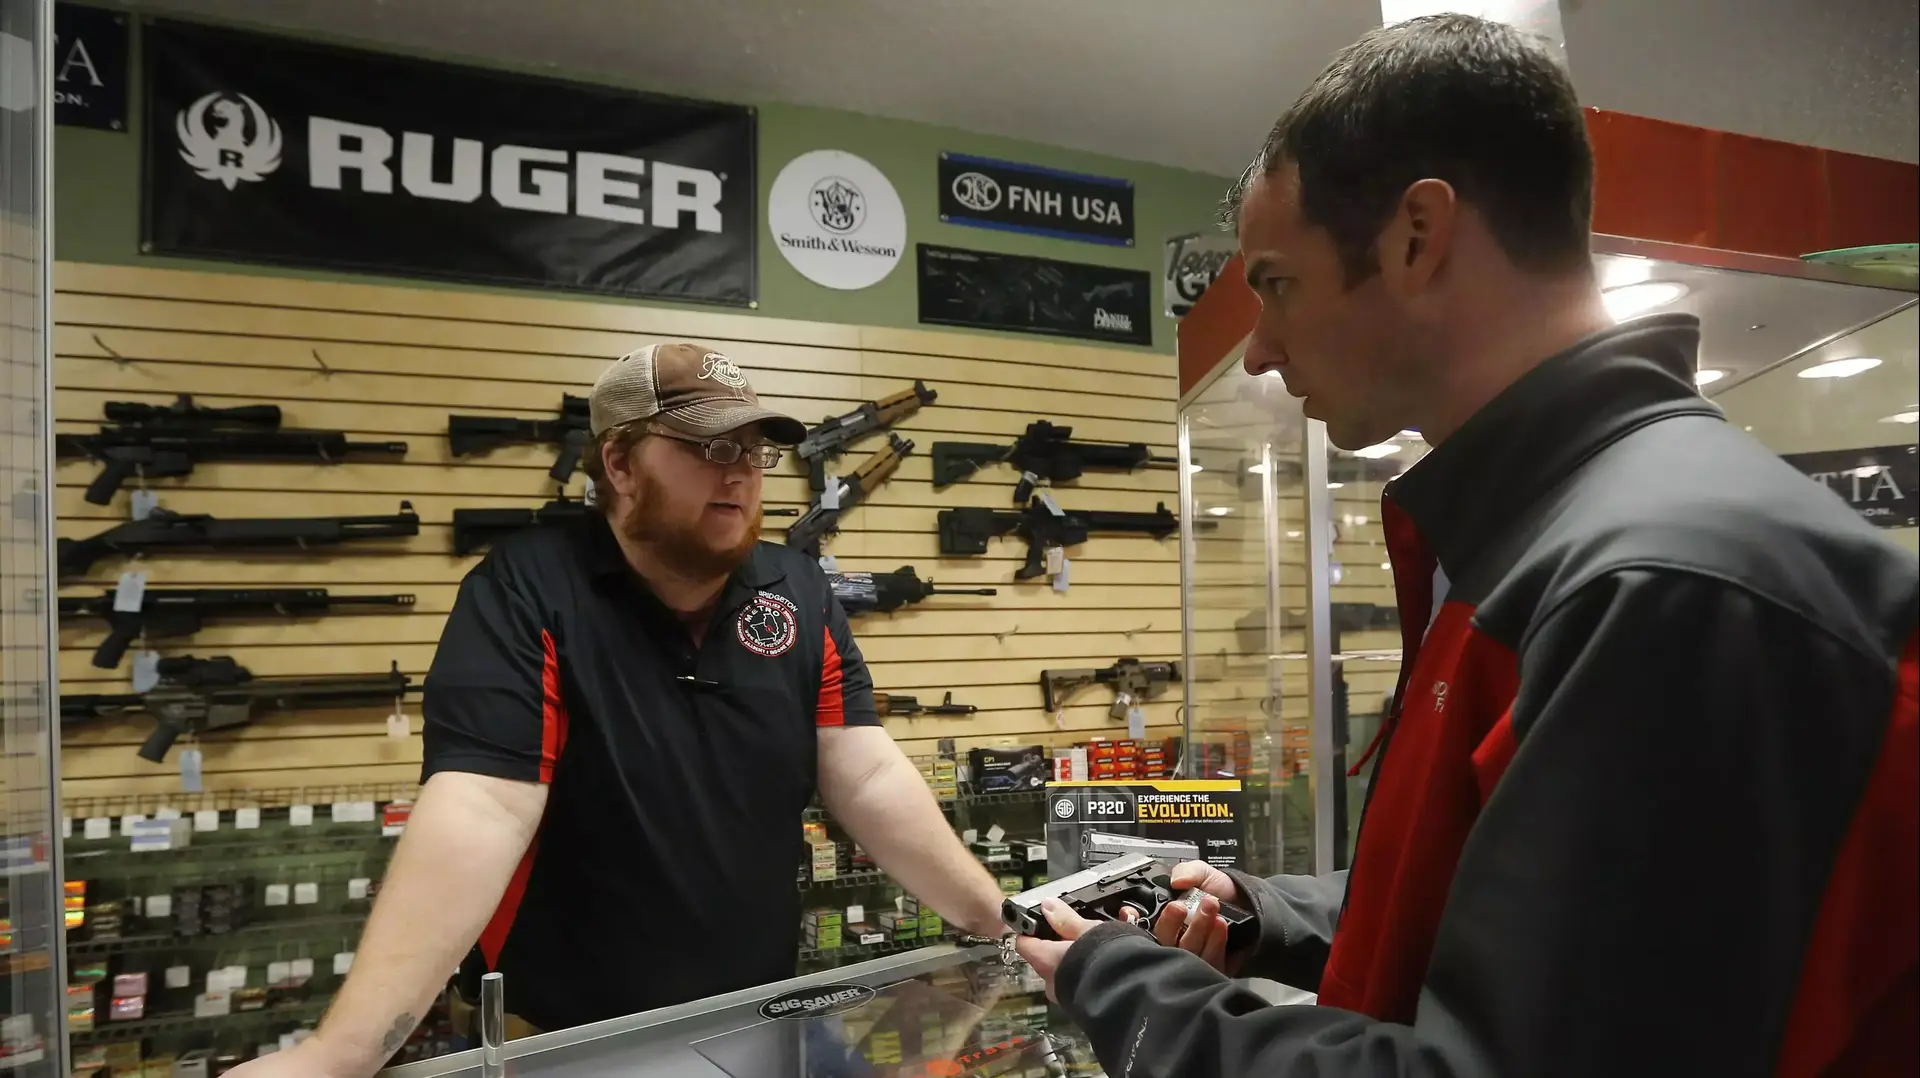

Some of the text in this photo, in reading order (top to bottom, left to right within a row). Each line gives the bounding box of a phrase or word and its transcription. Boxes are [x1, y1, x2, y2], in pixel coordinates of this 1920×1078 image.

[308, 115, 723, 233] RUGER
[1008, 185, 1122, 225] FNH USA
[758, 590, 798, 612] BRIDGETON
[744, 605, 780, 622] METRO
[1088, 801, 1125, 815] P320
[1137, 794, 1210, 803] EXPERIENCE THE
[1137, 803, 1234, 818] EVOLUTION.
[768, 988, 860, 1013] SIG SAUER
